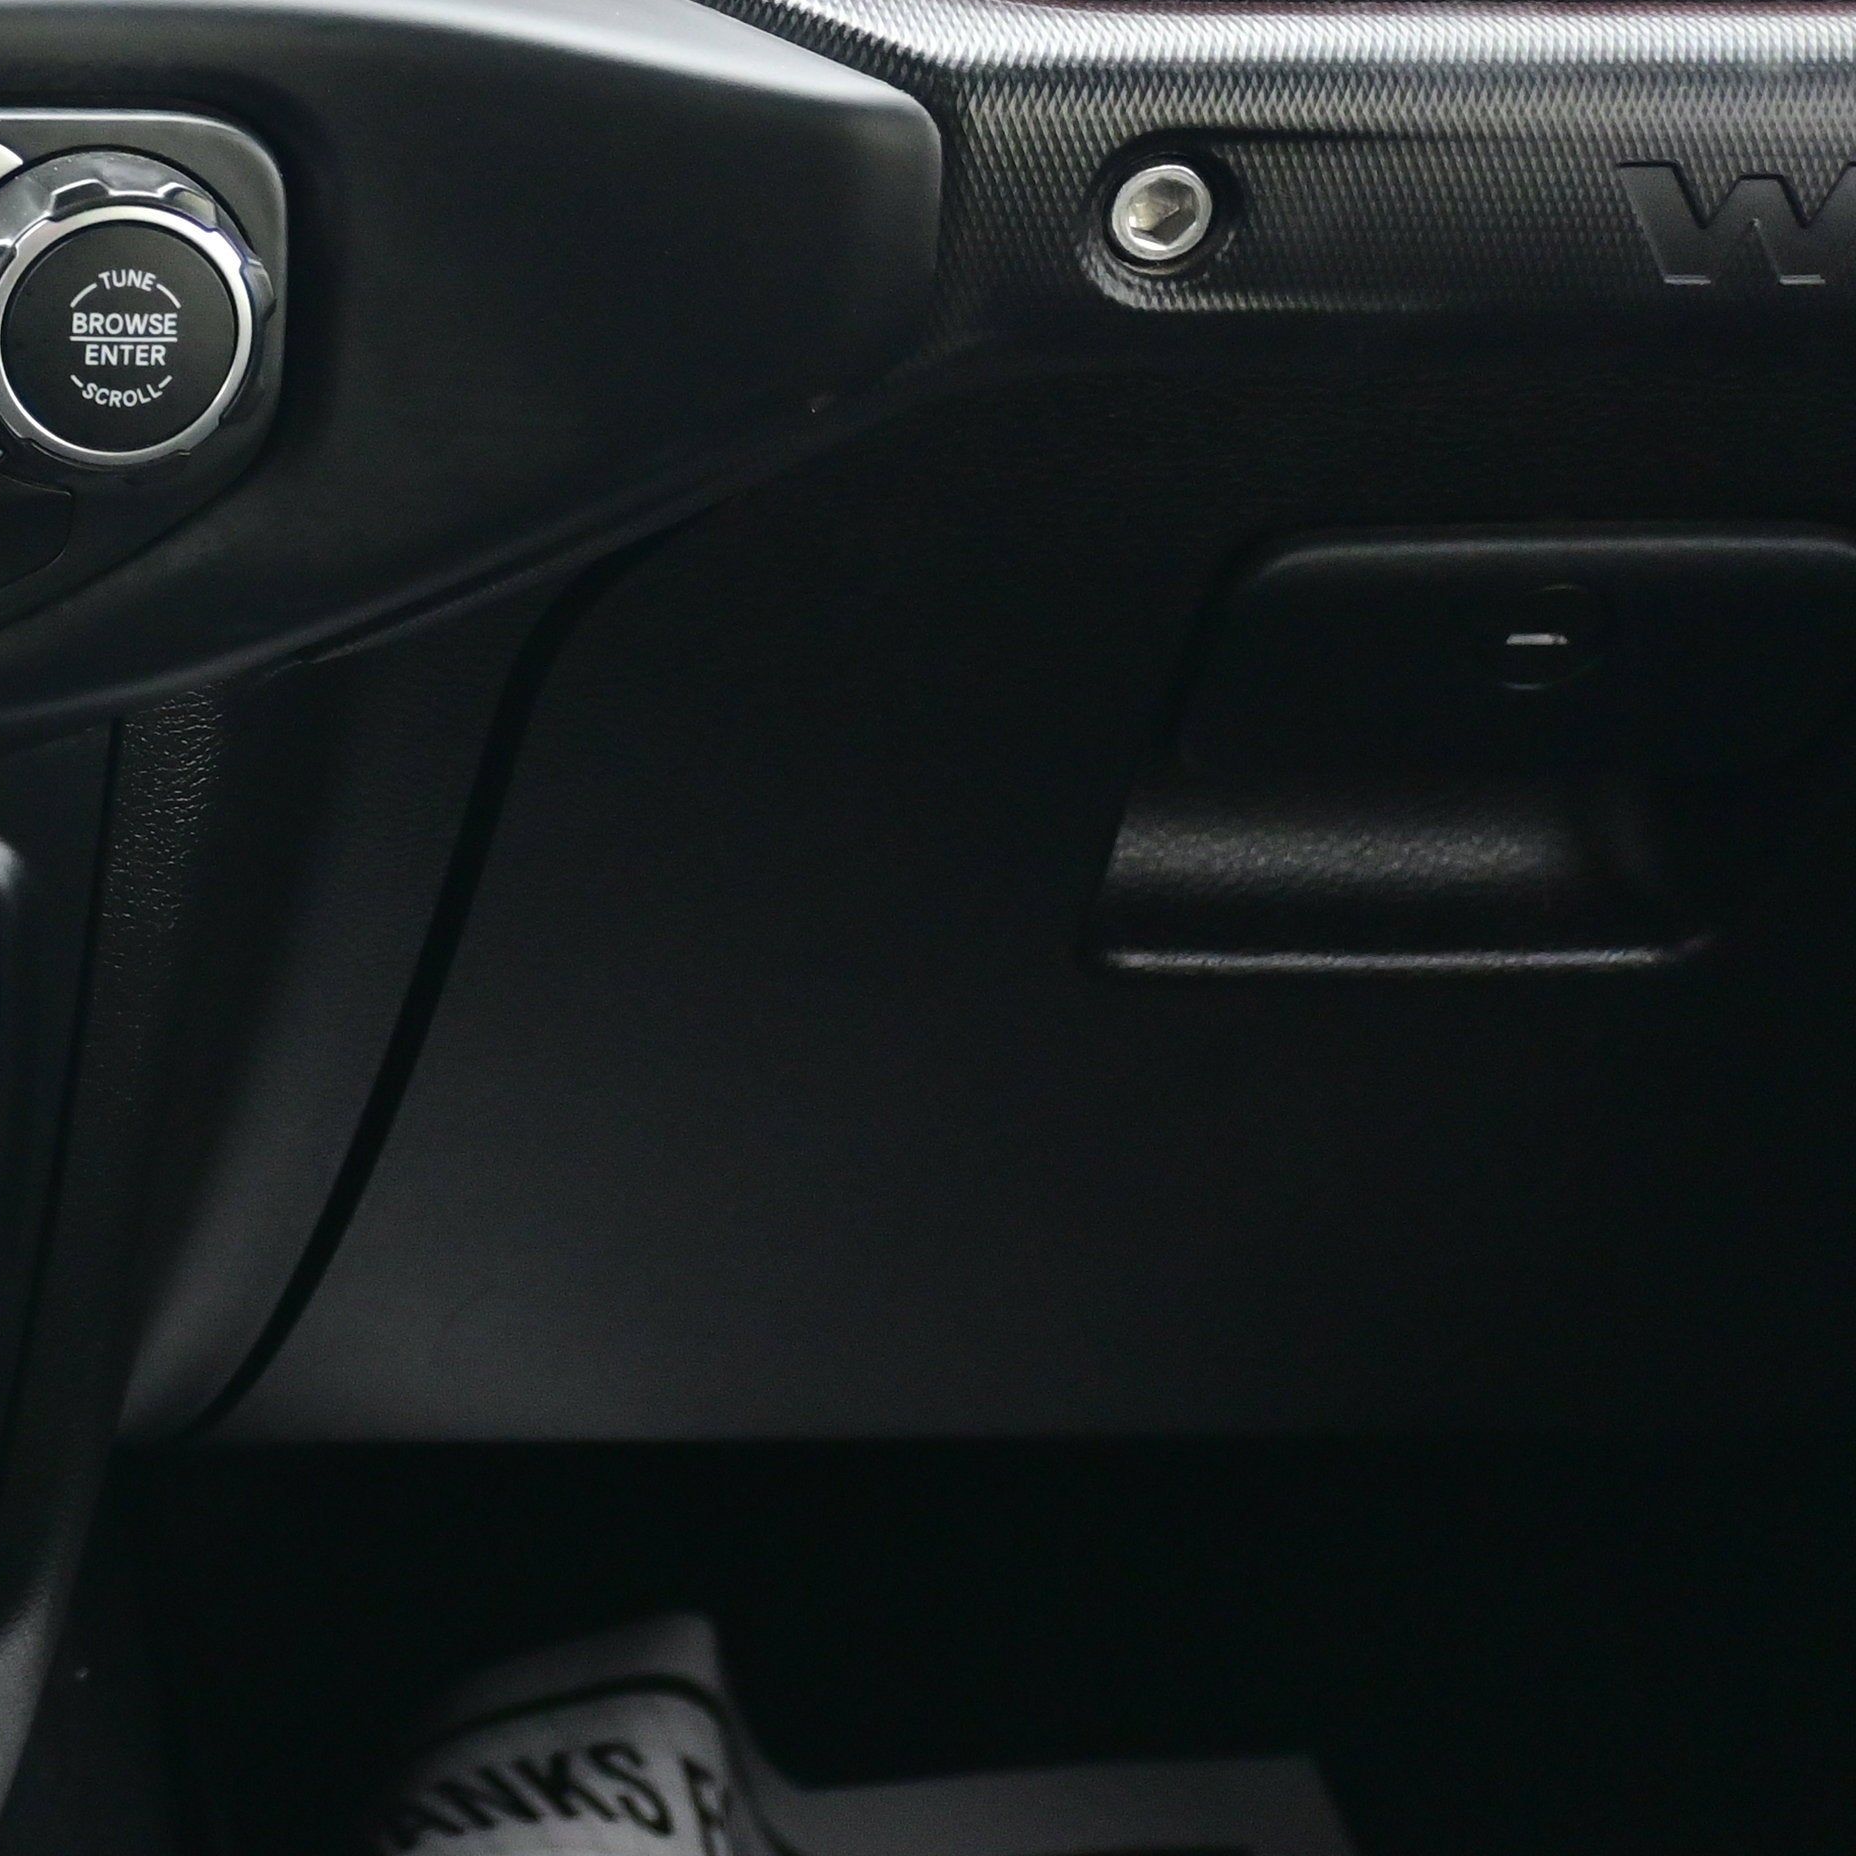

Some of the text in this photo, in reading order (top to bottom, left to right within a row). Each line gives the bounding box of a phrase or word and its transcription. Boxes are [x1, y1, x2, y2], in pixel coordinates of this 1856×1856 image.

[98, 269, 156, 292] TUNE
[71, 312, 178, 335] BROWSE
[84, 344, 167, 367] ENTER
[81, 382, 163, 408] SCROLL
